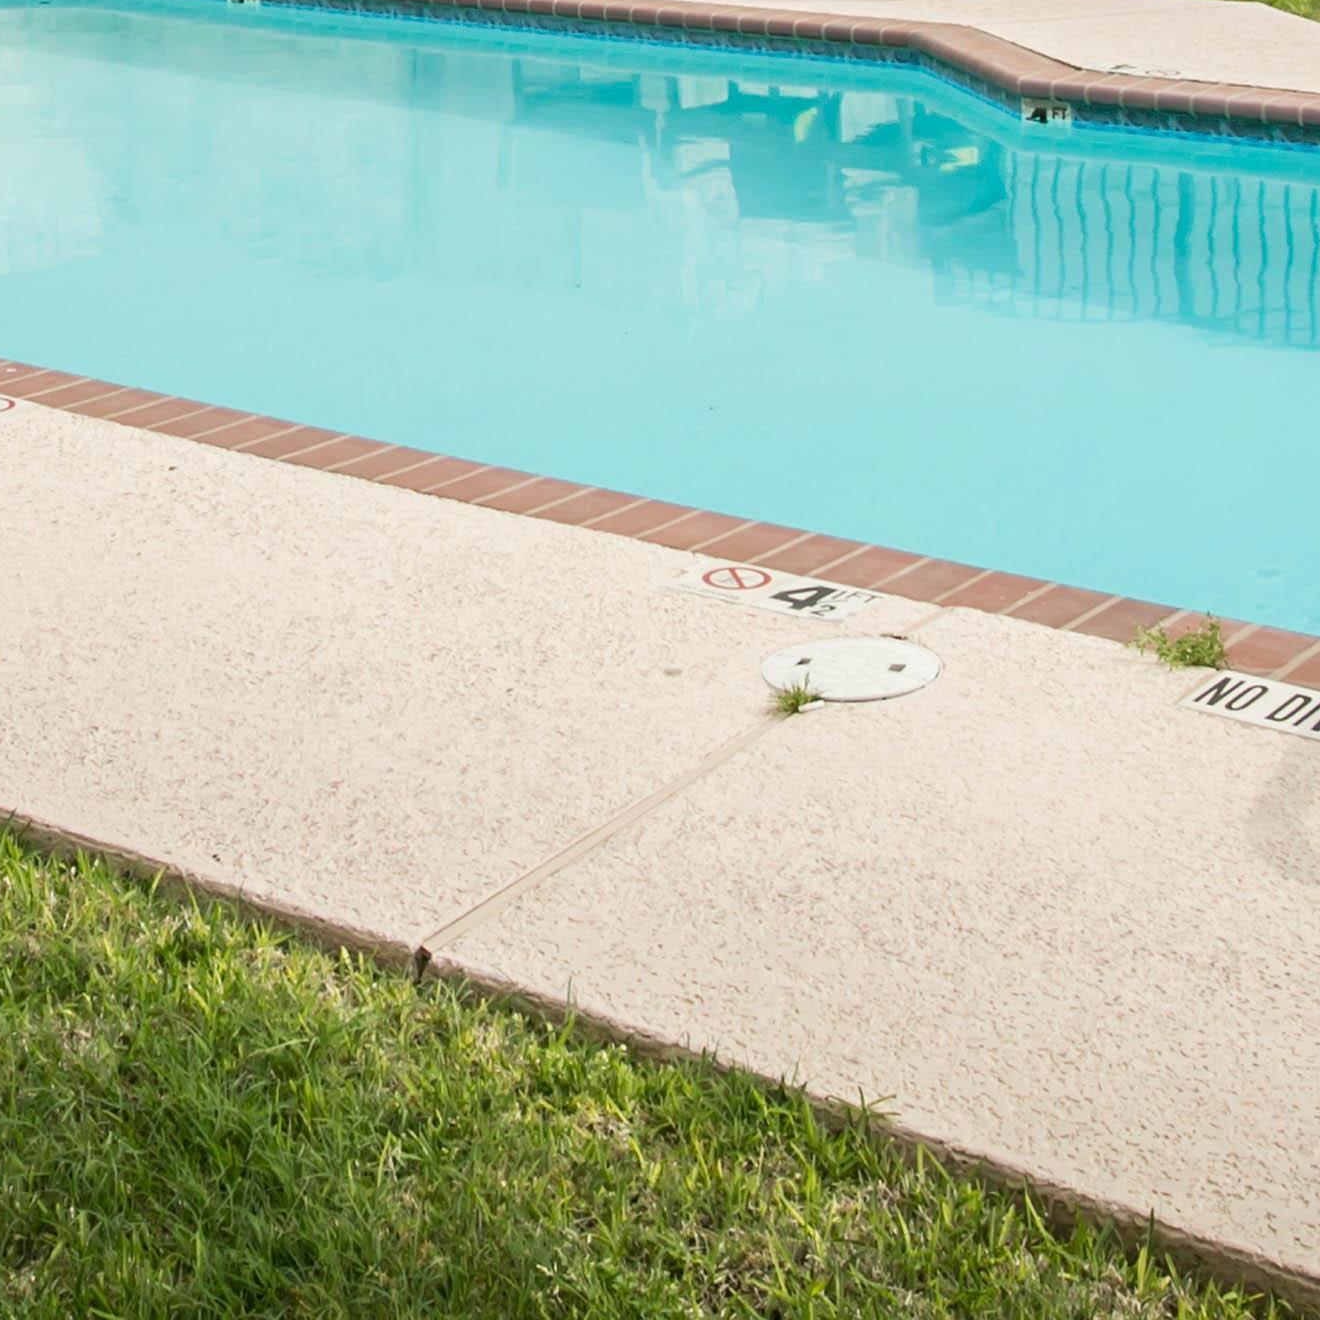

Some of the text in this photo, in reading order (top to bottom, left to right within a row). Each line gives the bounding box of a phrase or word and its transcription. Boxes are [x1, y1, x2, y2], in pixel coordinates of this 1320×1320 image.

[1025, 106, 1067, 124] 4 FT
[769, 585, 837, 611] 4
[1193, 677, 1269, 712] NO
